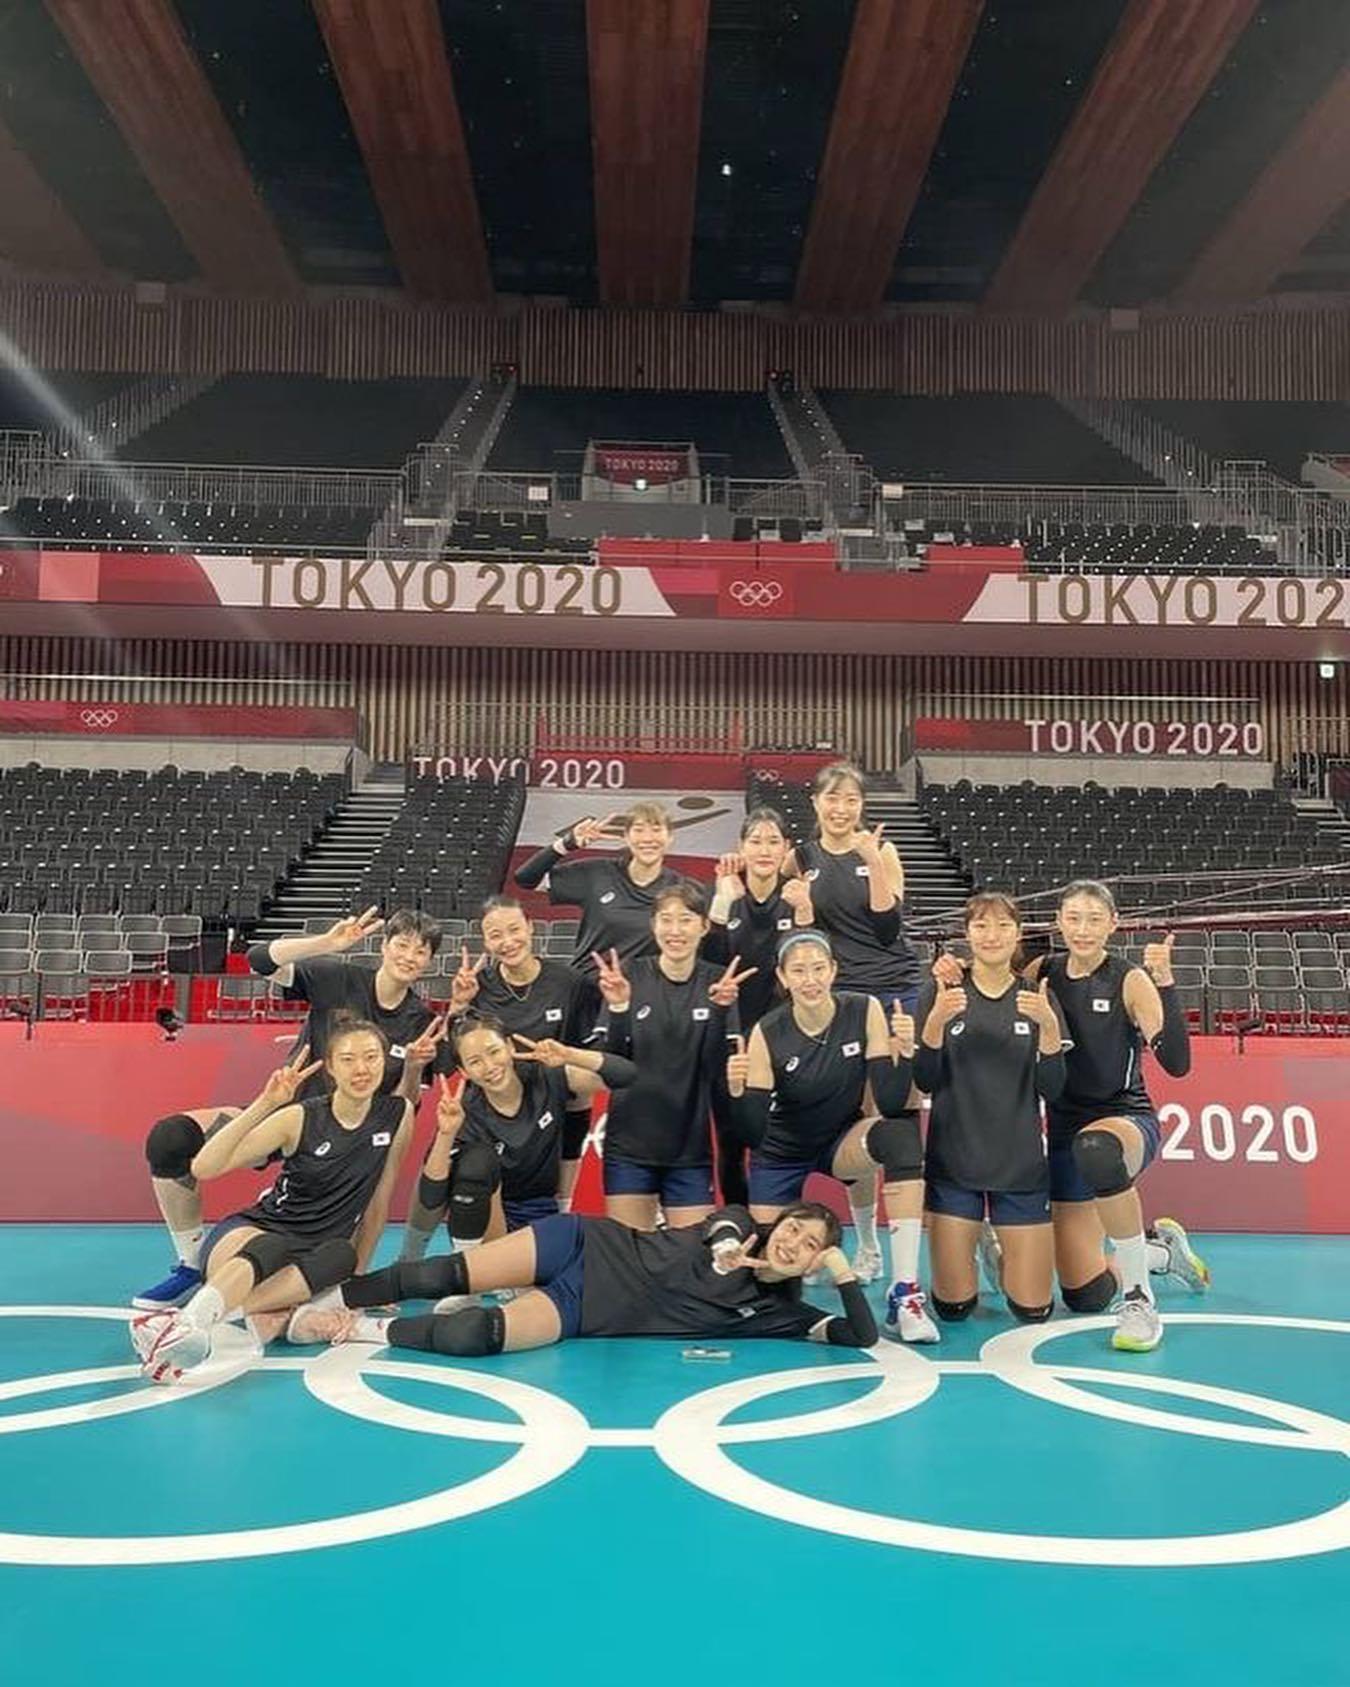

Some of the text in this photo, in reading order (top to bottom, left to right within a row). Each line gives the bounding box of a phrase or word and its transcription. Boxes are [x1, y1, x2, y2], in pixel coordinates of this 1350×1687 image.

[605, 458, 679, 471] TOKYO 2020
[252, 558, 622, 616] TOKYO 2020
[1017, 574, 1345, 627] TOKYO 202
[1024, 720, 1262, 755] TOKYO 2020
[540, 759, 624, 788] 2020
[1158, 1103, 1318, 1163] 2020
